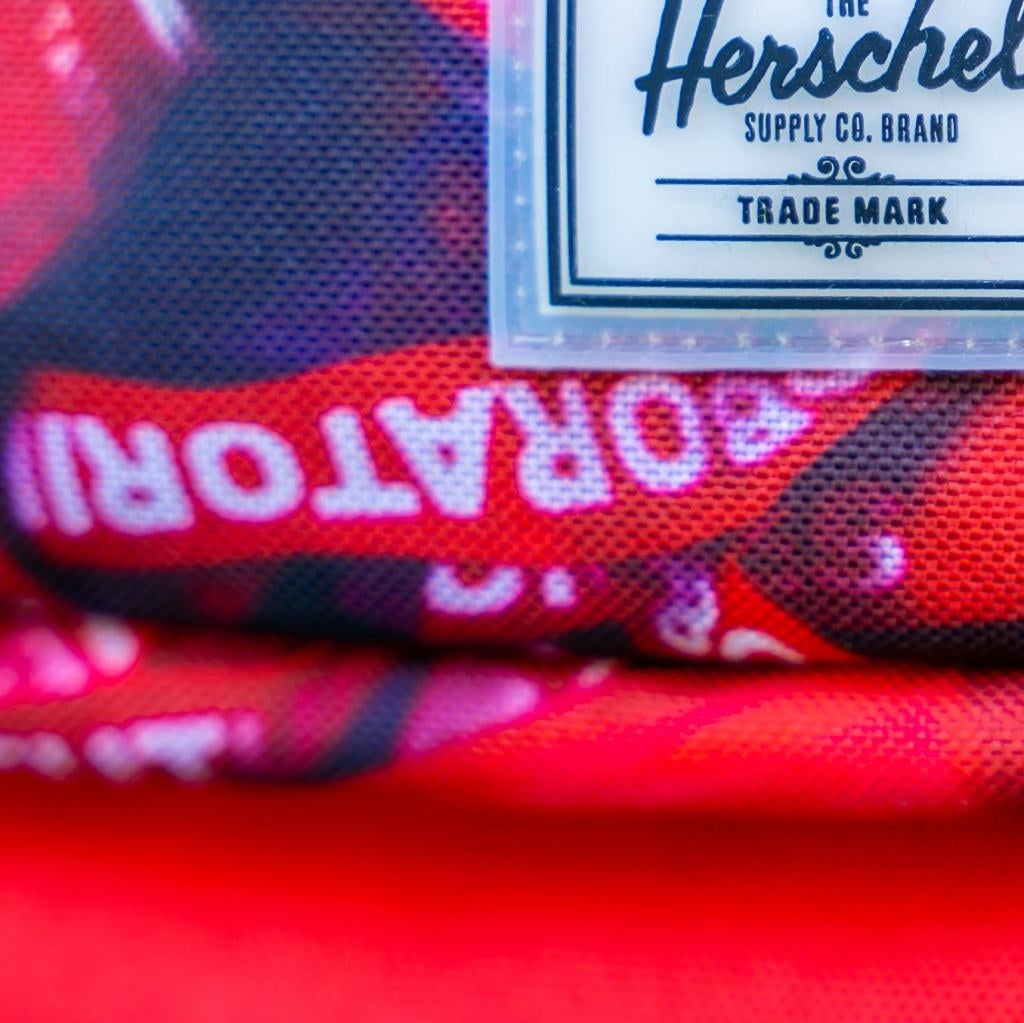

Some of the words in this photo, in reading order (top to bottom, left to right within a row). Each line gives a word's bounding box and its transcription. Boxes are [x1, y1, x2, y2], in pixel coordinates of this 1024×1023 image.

[744, 113, 825, 144] SUPPLY
[882, 113, 960, 144] BRAND
[737, 196, 840, 226] TRADE
[853, 196, 950, 226] MARK
